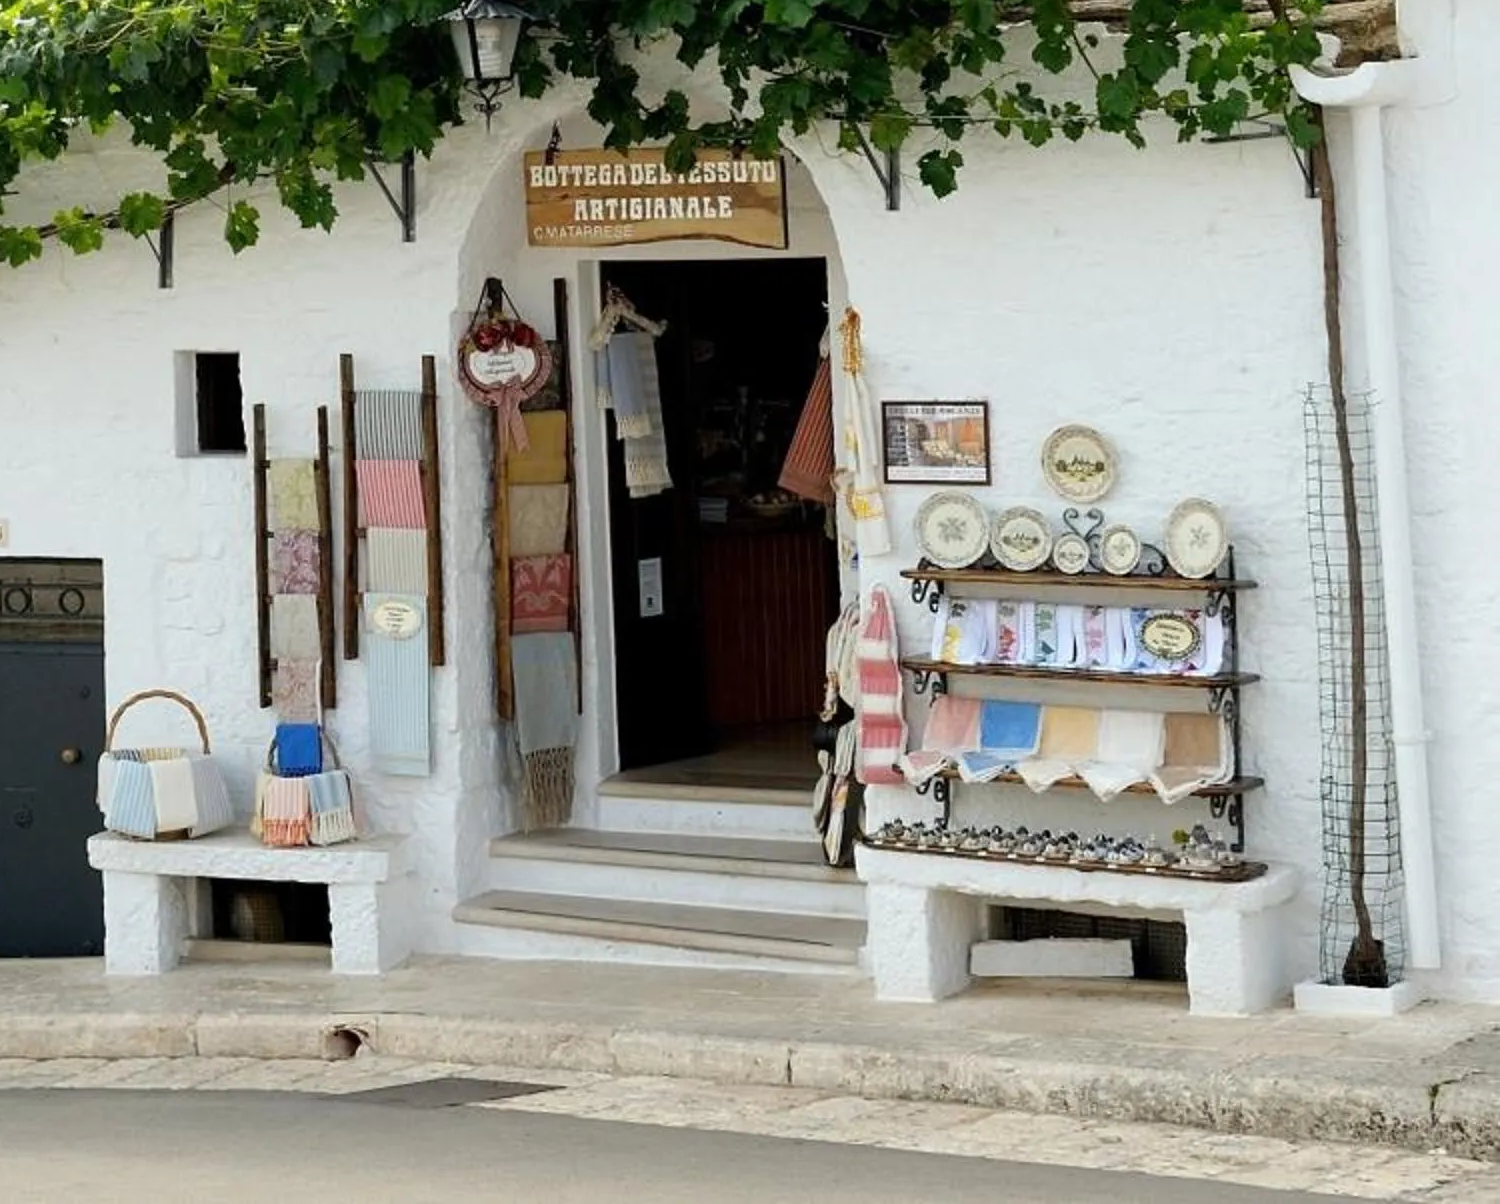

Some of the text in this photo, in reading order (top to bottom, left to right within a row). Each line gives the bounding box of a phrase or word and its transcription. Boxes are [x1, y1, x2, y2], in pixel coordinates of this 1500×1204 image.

[529, 160, 777, 187] BOTTEGA DEL ESSUTO
[573, 195, 733, 221] ARTIGIANALE
